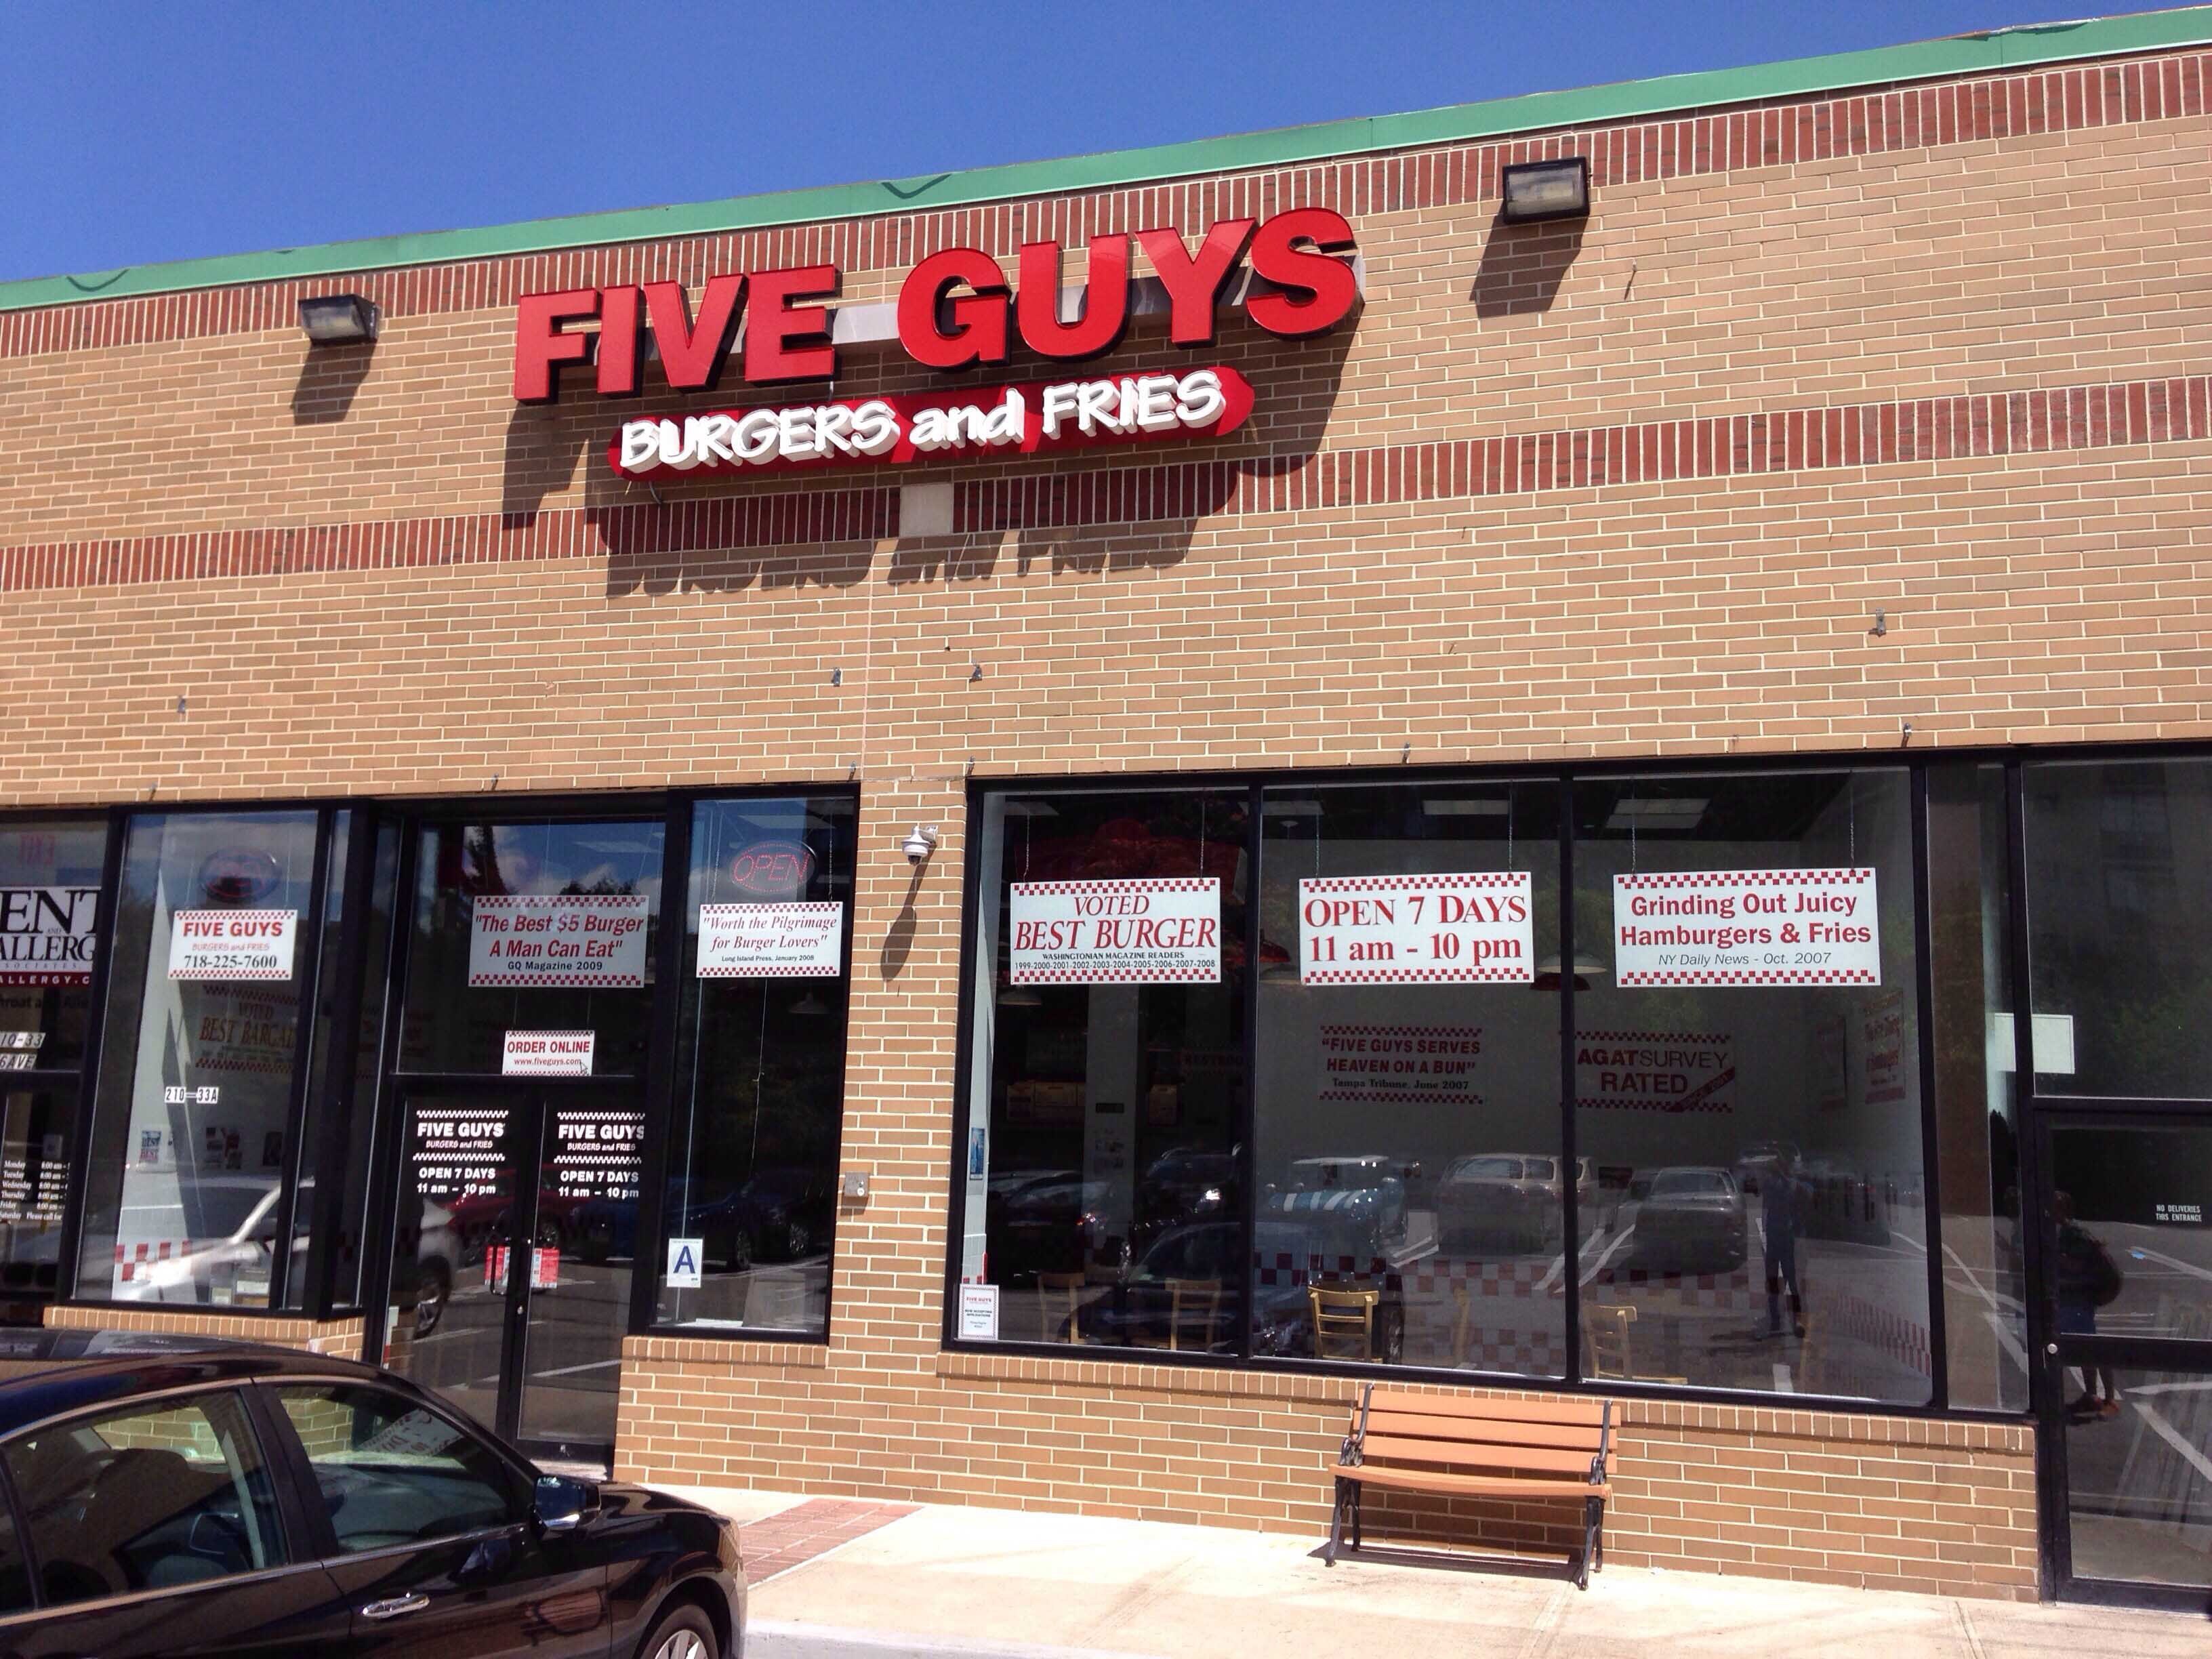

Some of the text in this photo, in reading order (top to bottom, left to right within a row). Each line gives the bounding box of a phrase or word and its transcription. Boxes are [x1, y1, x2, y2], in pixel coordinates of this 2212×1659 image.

[514, 207, 1361, 403] FIVE GUYS
[619, 369, 1227, 472] BURGERS and FRIES
[733, 852, 811, 882] OPEN
[1074, 895, 1150, 916] VOTED
[1305, 895, 1526, 928] OPEN 7 DAYS
[1631, 892, 1858, 918] Grinding Out Juicy
[183, 921, 283, 937] FIVE GUYS
[476, 913, 644, 936] "The Best $5 Burger
[703, 915, 837, 932] "Worth the Pilgrimage
[1014, 918, 1217, 951] BEST BURGER
[1620, 922, 1871, 949] Hamburgers & Fries
[192, 943, 270, 951] BURGERS and FRIES
[489, 939, 623, 958] A Man Can Eat"
[710, 935, 828, 952] for Burger Lovers"
[1309, 936, 1336, 962] 11
[1349, 940, 1394, 961] am
[1429, 933, 1460, 960] 10
[1472, 938, 1523, 966] pm
[184, 955, 277, 968] 718-225-7600
[508, 961, 602, 972] GQ Magazine 2009
[1658, 954, 1677, 965] NY
[1679, 953, 1711, 967] Daily
[1714, 954, 1749, 965] News
[1763, 953, 1788, 964] Oct.
[1795, 952, 1832, 964] 2007
[199, 1017, 235, 1043] BEST
[507, 1041, 590, 1053] ORDER ONLINE
[1370, 1040, 1413, 1052] GUYS
[1418, 1040, 1481, 1054] SERVES
[514, 1058, 581, 1066] www.fiveguys.com
[1327, 1059, 1389, 1072] HEAVEN
[1393, 1061, 1415, 1073] ON
[1419, 1061, 1429, 1073] A
[1332, 1078, 1366, 1088] Tampa
[1414, 1080, 1438, 1090] June
[1443, 1080, 1469, 1090] 2007
[1599, 1072, 1688, 1094] RATED
[417, 1122, 504, 1137] FIVE GUYS
[558, 1124, 644, 1140] FIVE GUYS
[426, 1140, 459, 1149] BURGERS
[473, 1141, 493, 1149] FRIES
[567, 1143, 600, 1151] BURGERS
[4, 1161, 26, 1170] Monday
[3, 1171, 24, 1180] Tuesday
[419, 1168, 495, 1179] OPEN 7 DAYS
[560, 1170, 638, 1182] OPEN 7 DAYS
[2, 1181, 32, 1190] Wednesday
[417, 1183, 428, 1193] 11
[464, 1184, 476, 1193] 10
[478, 1186, 496, 1195] pm
[1, 1191, 25, 1200] Thursday
[558, 1187, 569, 1197] 11
[607, 1187, 619, 1197] 10
[621, 1189, 639, 1200] pm
[0, 1201, 17, 1210] Friday
[2168, 1204, 2200, 1213] DELIVERIES
[26, 1212, 43, 1220] Please
[2171, 1214, 2202, 1222] ENTRANCE
[673, 1245, 695, 1273] A
